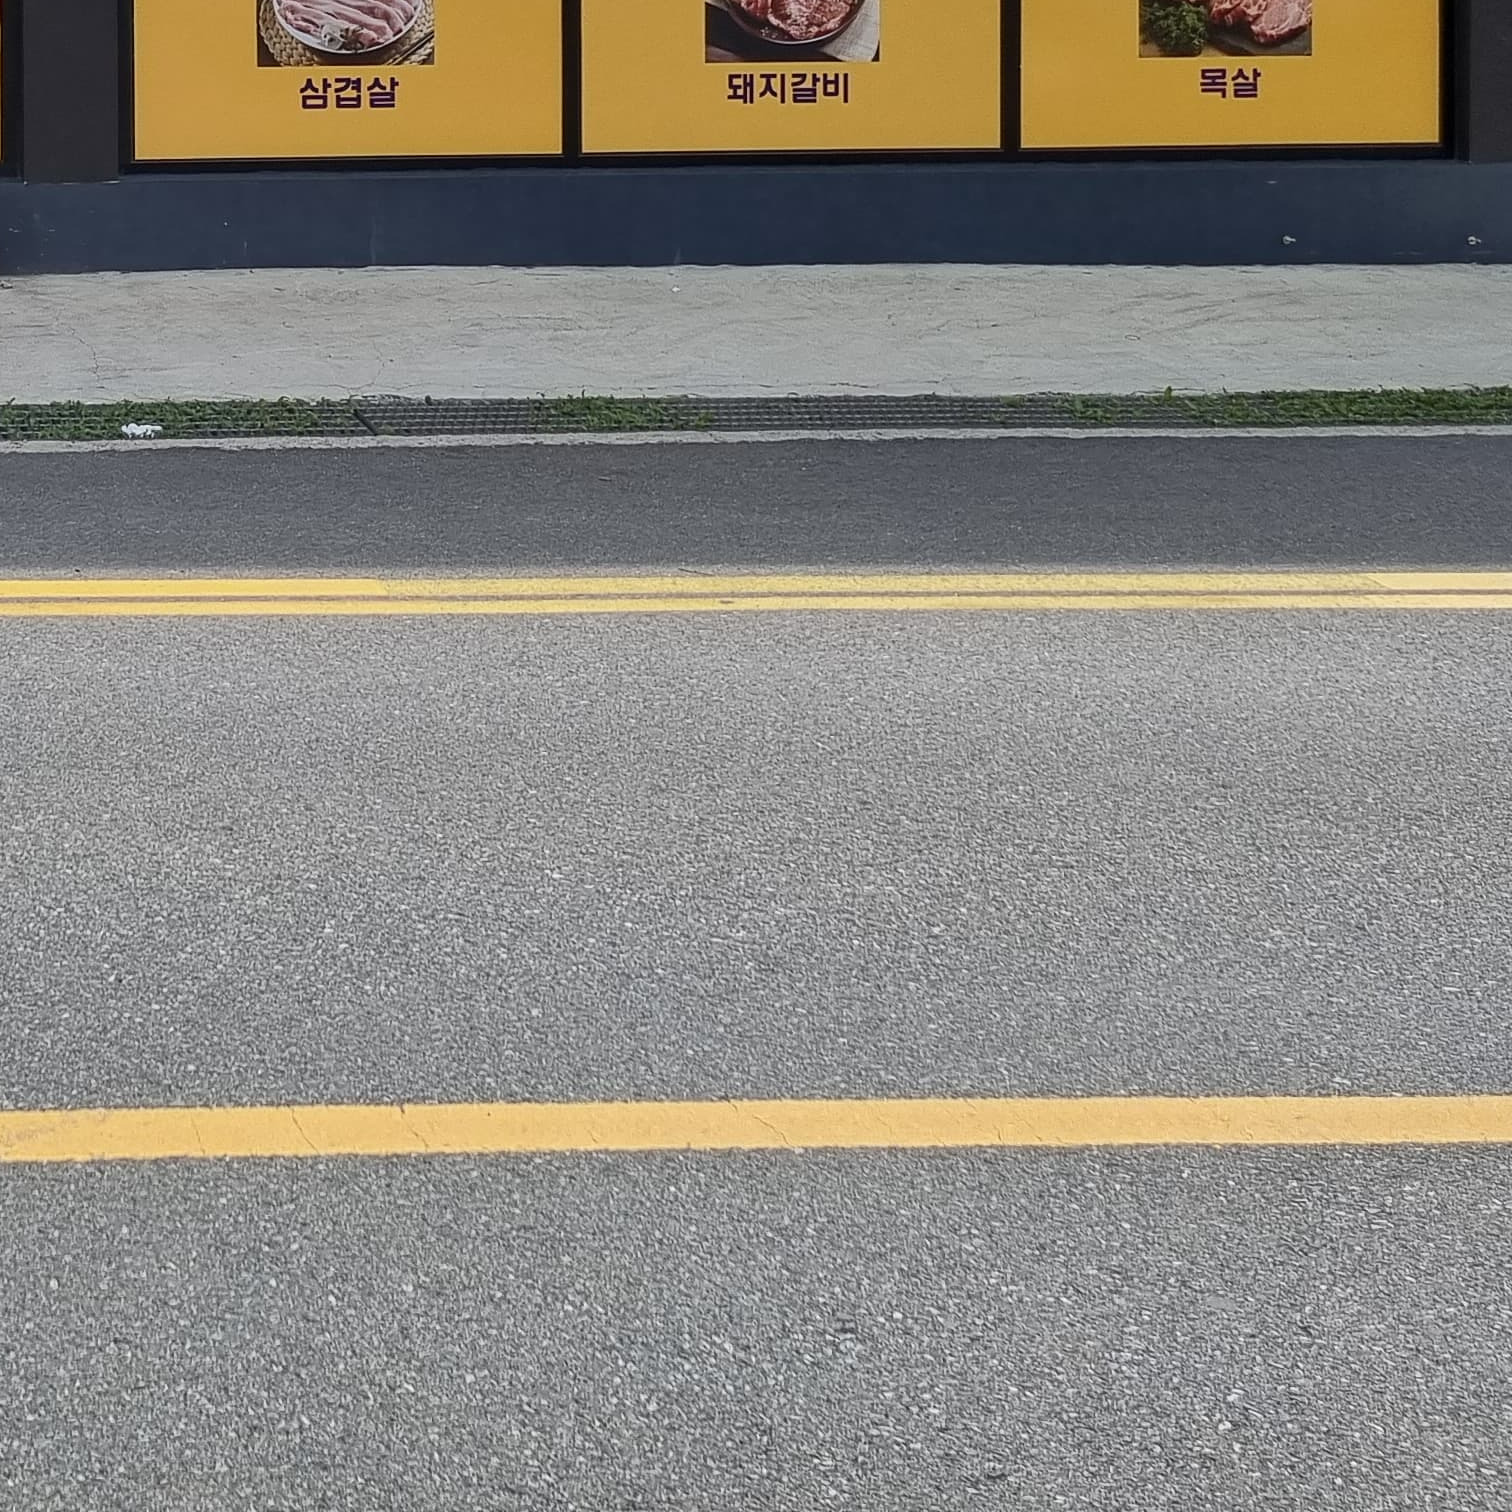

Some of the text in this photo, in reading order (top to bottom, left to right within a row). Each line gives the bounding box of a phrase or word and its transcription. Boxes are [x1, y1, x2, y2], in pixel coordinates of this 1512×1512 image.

[299, 76, 400, 109] 삼겹살
[726, 73, 851, 104] 돼지갈비
[1199, 67, 1262, 99] 목살
